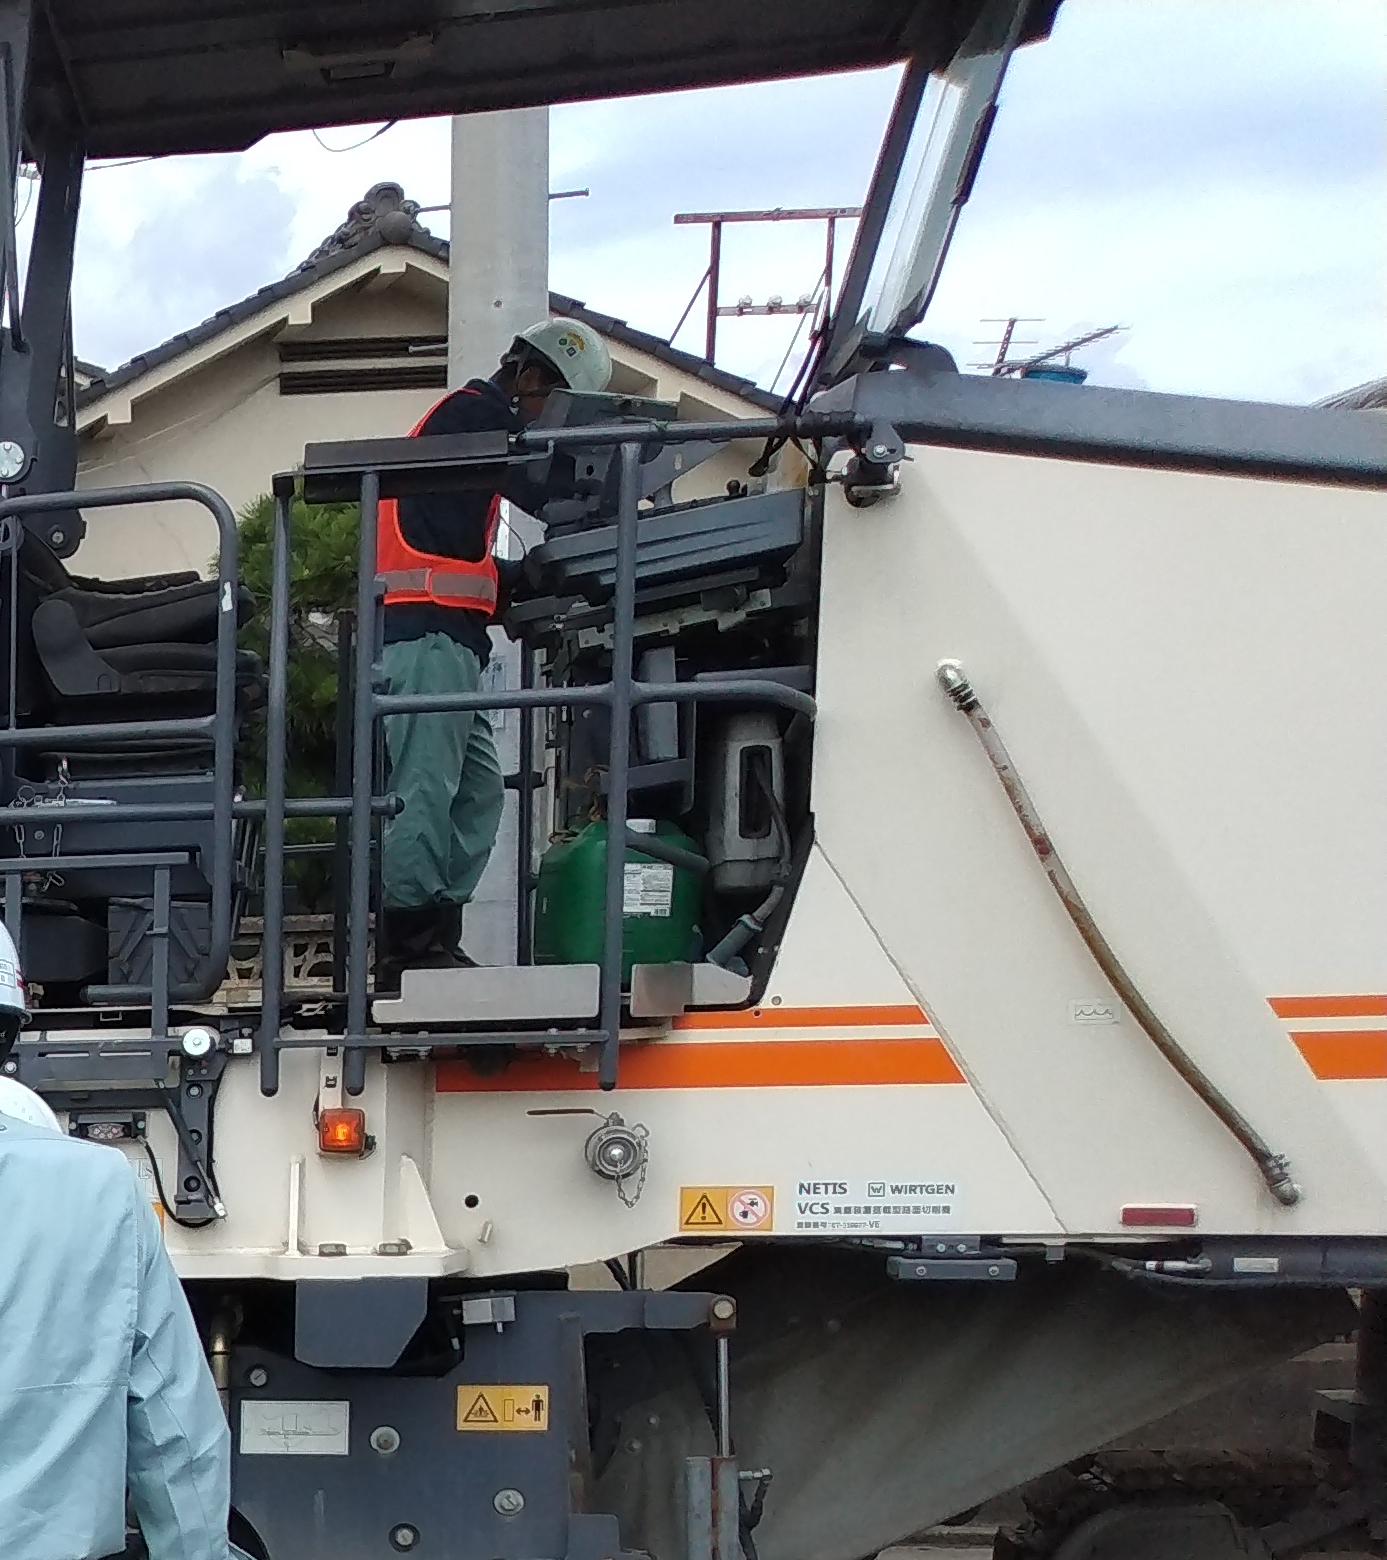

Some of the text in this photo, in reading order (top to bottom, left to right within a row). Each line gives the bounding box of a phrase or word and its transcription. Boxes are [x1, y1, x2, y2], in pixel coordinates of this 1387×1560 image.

[798, 1182, 848, 1195] NETIS
[890, 1184, 956, 1196] WIRTGEN
[797, 1202, 830, 1215] VCS
